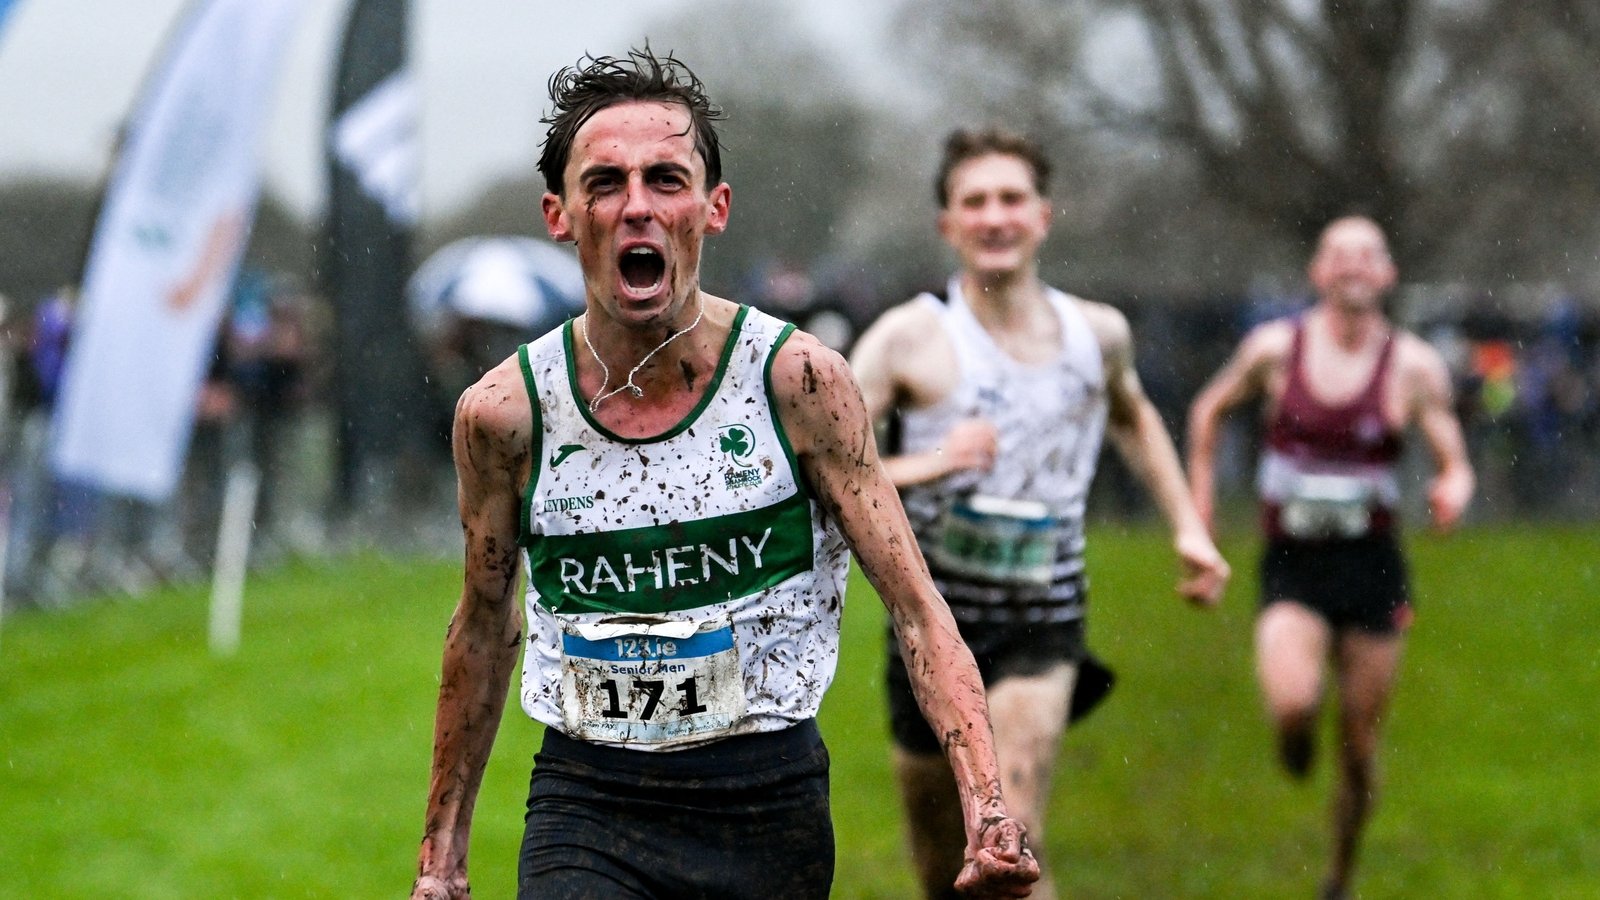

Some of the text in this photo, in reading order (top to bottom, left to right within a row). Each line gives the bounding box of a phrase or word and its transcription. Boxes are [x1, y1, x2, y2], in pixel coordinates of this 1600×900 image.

[544, 496, 594, 512] LEYDENS
[559, 527, 772, 594] RAHENY
[615, 637, 677, 657] 123.ie
[611, 664, 686, 674] Senior Men
[600, 677, 707, 720] 171
